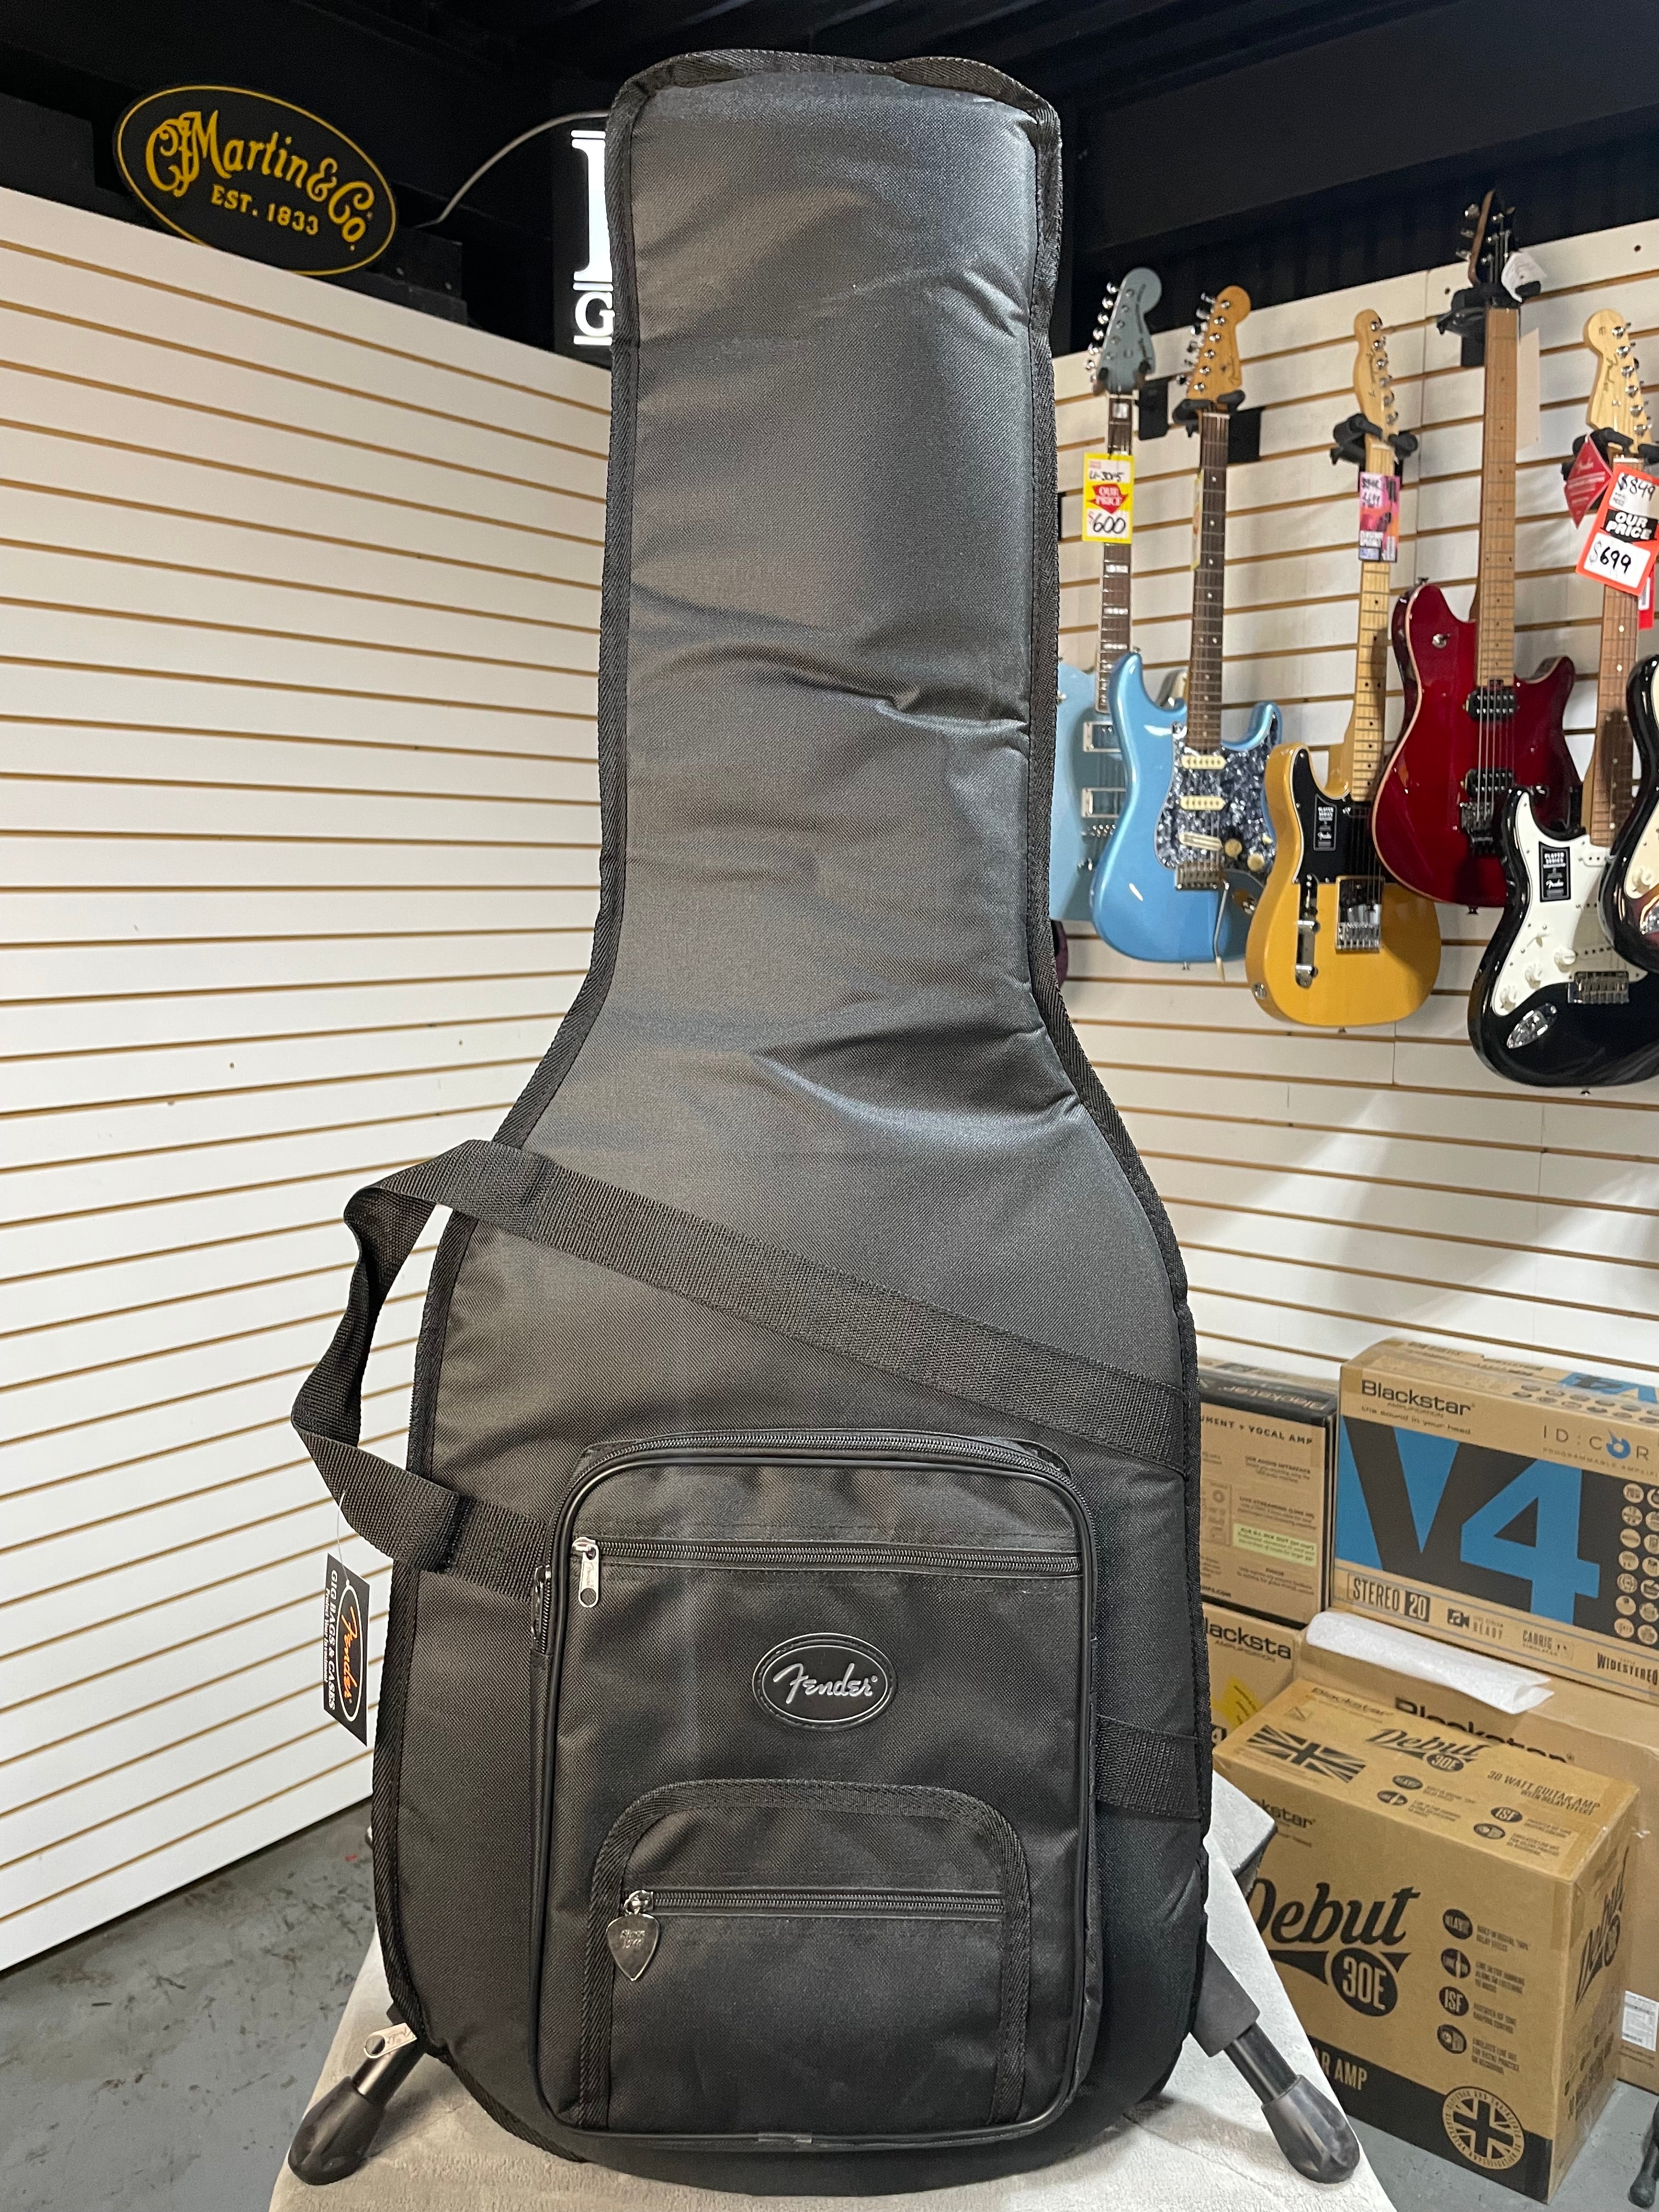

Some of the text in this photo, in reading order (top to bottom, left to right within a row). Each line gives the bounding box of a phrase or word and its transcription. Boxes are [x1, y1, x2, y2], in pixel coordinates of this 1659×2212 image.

[211, 183, 319, 236] EST. 1833
[1618, 472, 1656, 501] $849
[1605, 520, 1652, 540] PRICE
[1614, 511, 1649, 528] OUR
[1589, 540, 1632, 574] $699
[1361, 1379, 1471, 1415] Blackstar
[1249, 1425, 1285, 1440] VOCAL
[1289, 1434, 1313, 1444] AMP
[1353, 1577, 1427, 1620] STEREO 20
[328, 1603, 336, 1645] BAGS
[341, 1606, 358, 1700] Fender
[328, 1660, 336, 1711] CASES
[772, 1662, 873, 1705] Fender
[1365, 1728, 1492, 1756] Debut
[1504, 1775, 1534, 1790] WATT
[1342, 1956, 1387, 2011] 30E
[1444, 1989, 1464, 2013] ISF
[1334, 2057, 1368, 2091] AMP
